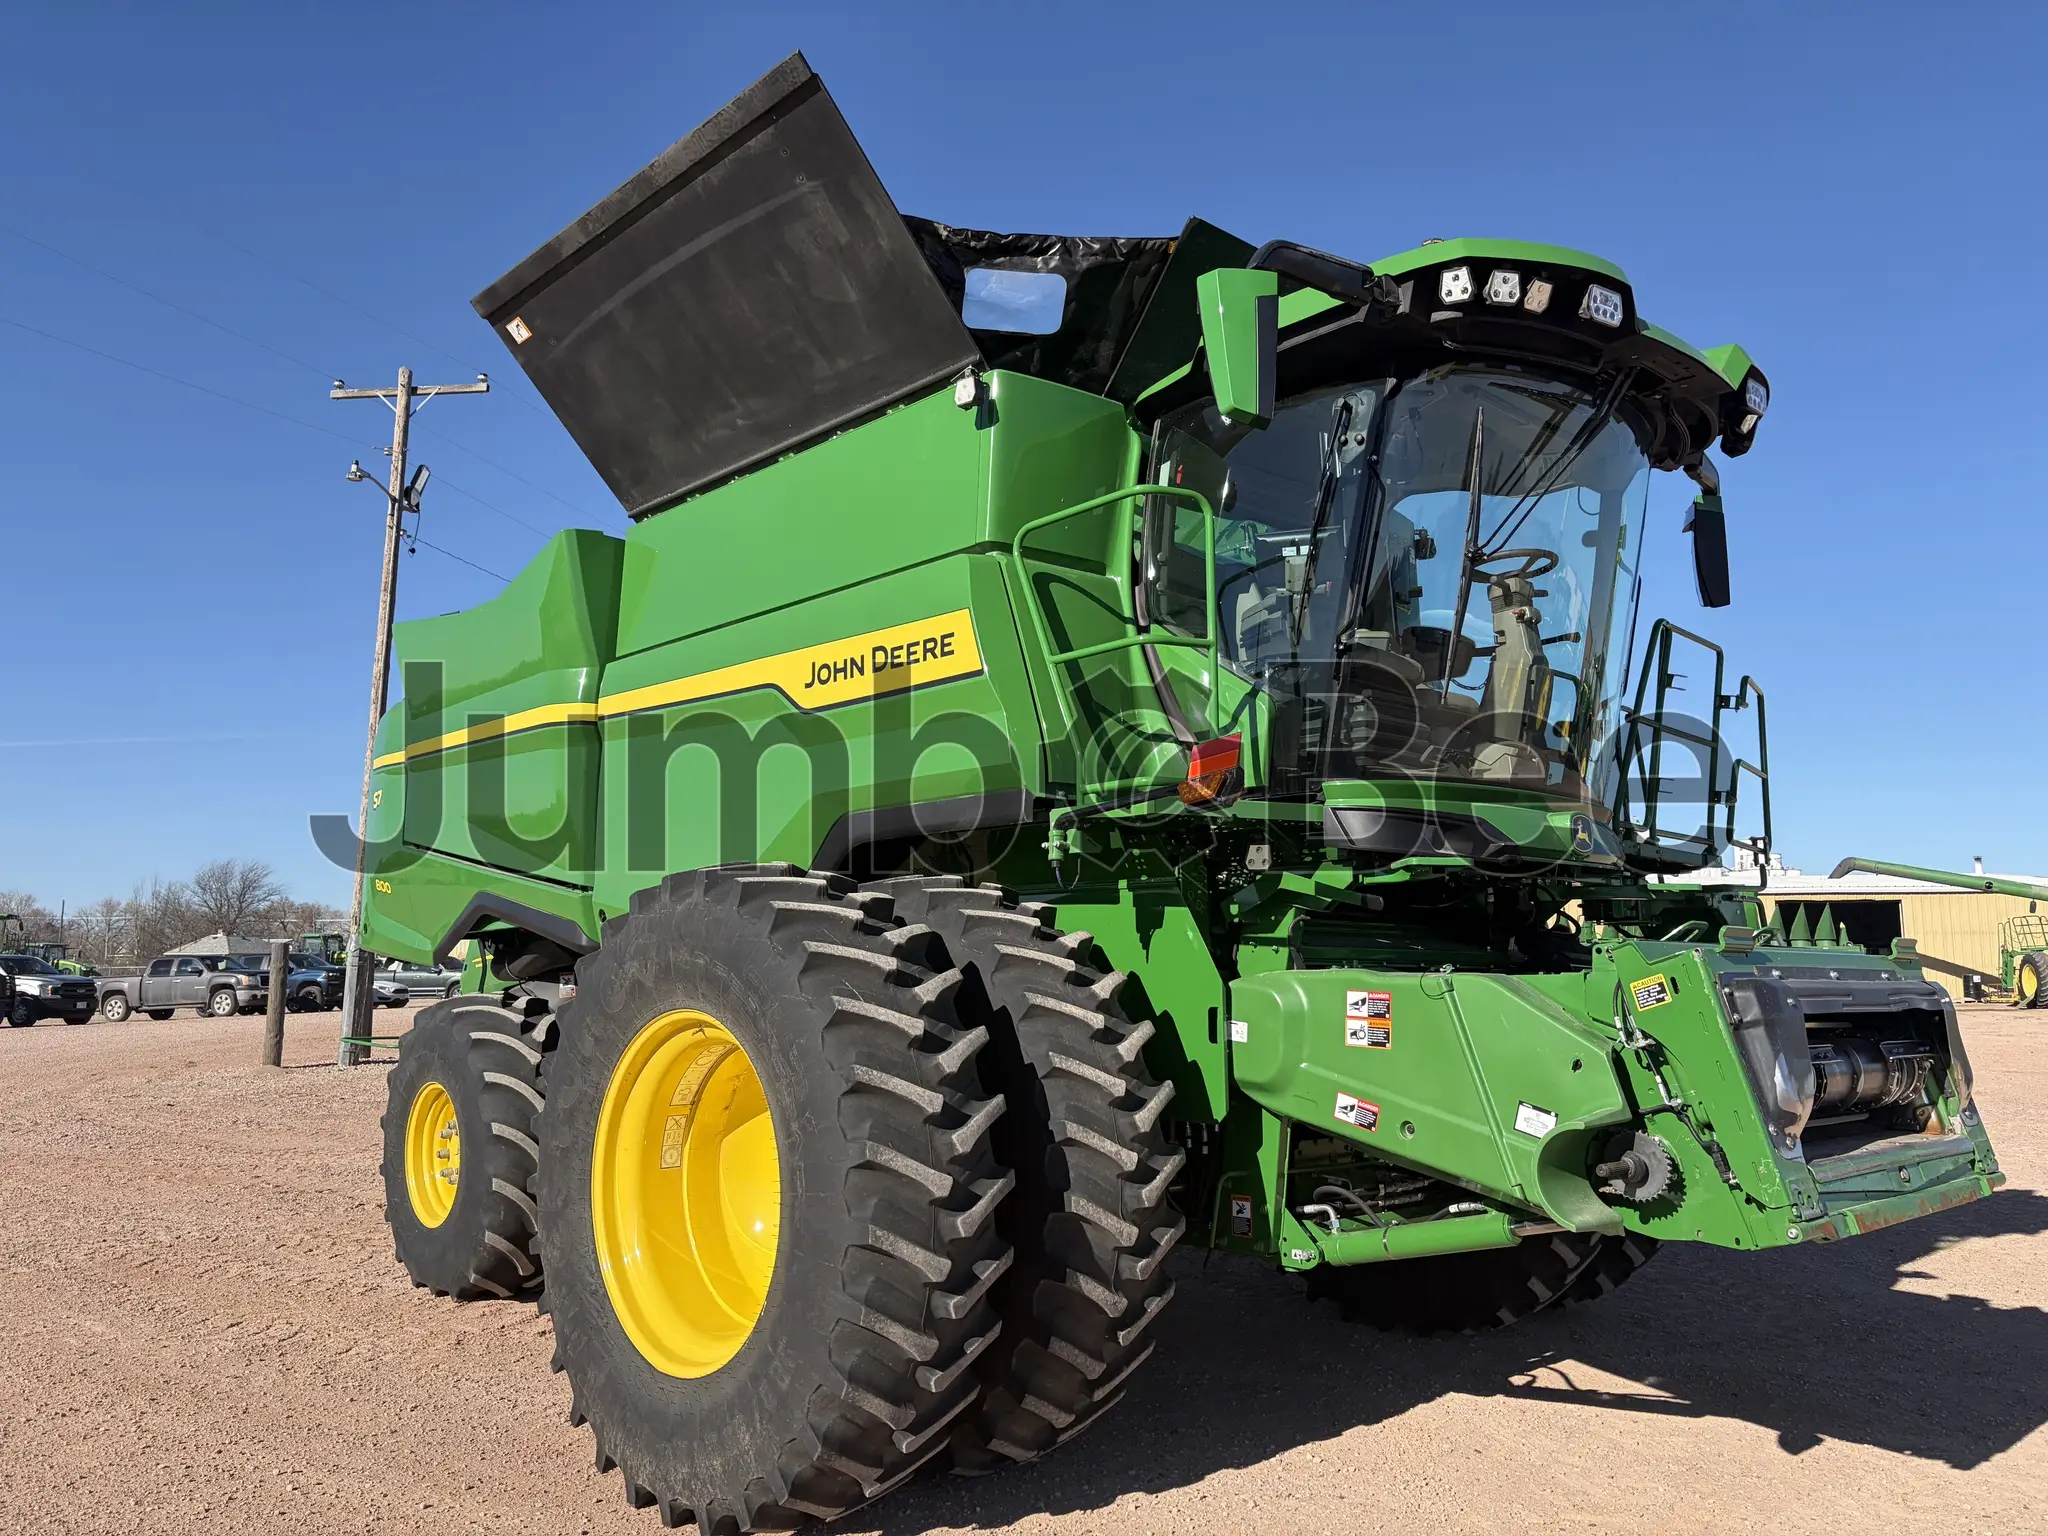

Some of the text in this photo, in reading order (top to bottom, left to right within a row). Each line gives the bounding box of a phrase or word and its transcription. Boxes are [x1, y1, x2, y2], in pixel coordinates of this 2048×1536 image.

[804, 632, 955, 689] JOHN DEERE
[375, 879, 392, 894] 800
[1636, 975, 1663, 988] CAUTION
[1361, 1101, 1379, 1113] DANGER
